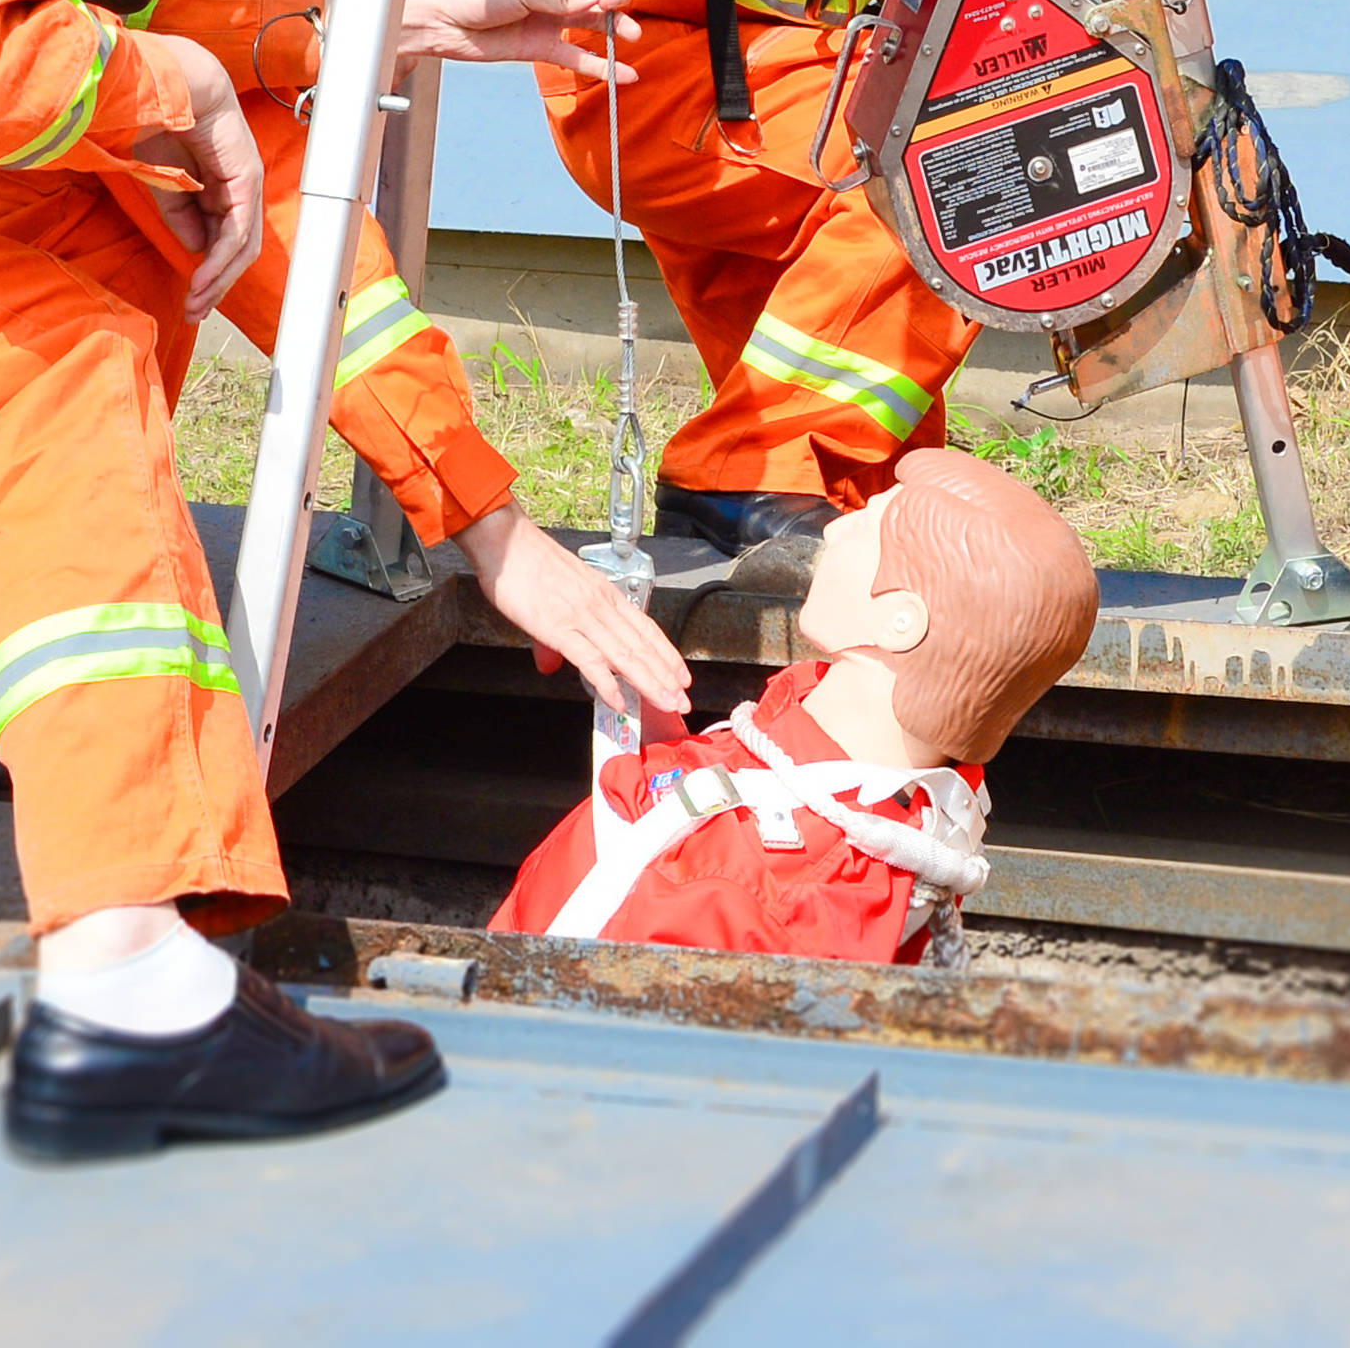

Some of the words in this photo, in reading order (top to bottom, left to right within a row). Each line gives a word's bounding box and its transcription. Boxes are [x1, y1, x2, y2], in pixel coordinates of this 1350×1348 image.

[973, 33, 1048, 76] MILLER
[992, 88, 1037, 109] WARNING
[1088, 191, 1153, 218] SELF-RETRACTING
[1035, 225, 1053, 236] WITH
[1056, 214, 1086, 229] LIFELINE
[989, 232, 1034, 251] EMERGENCY
[959, 248, 988, 262] RESCUE
[1031, 256, 1106, 292] MILLER
